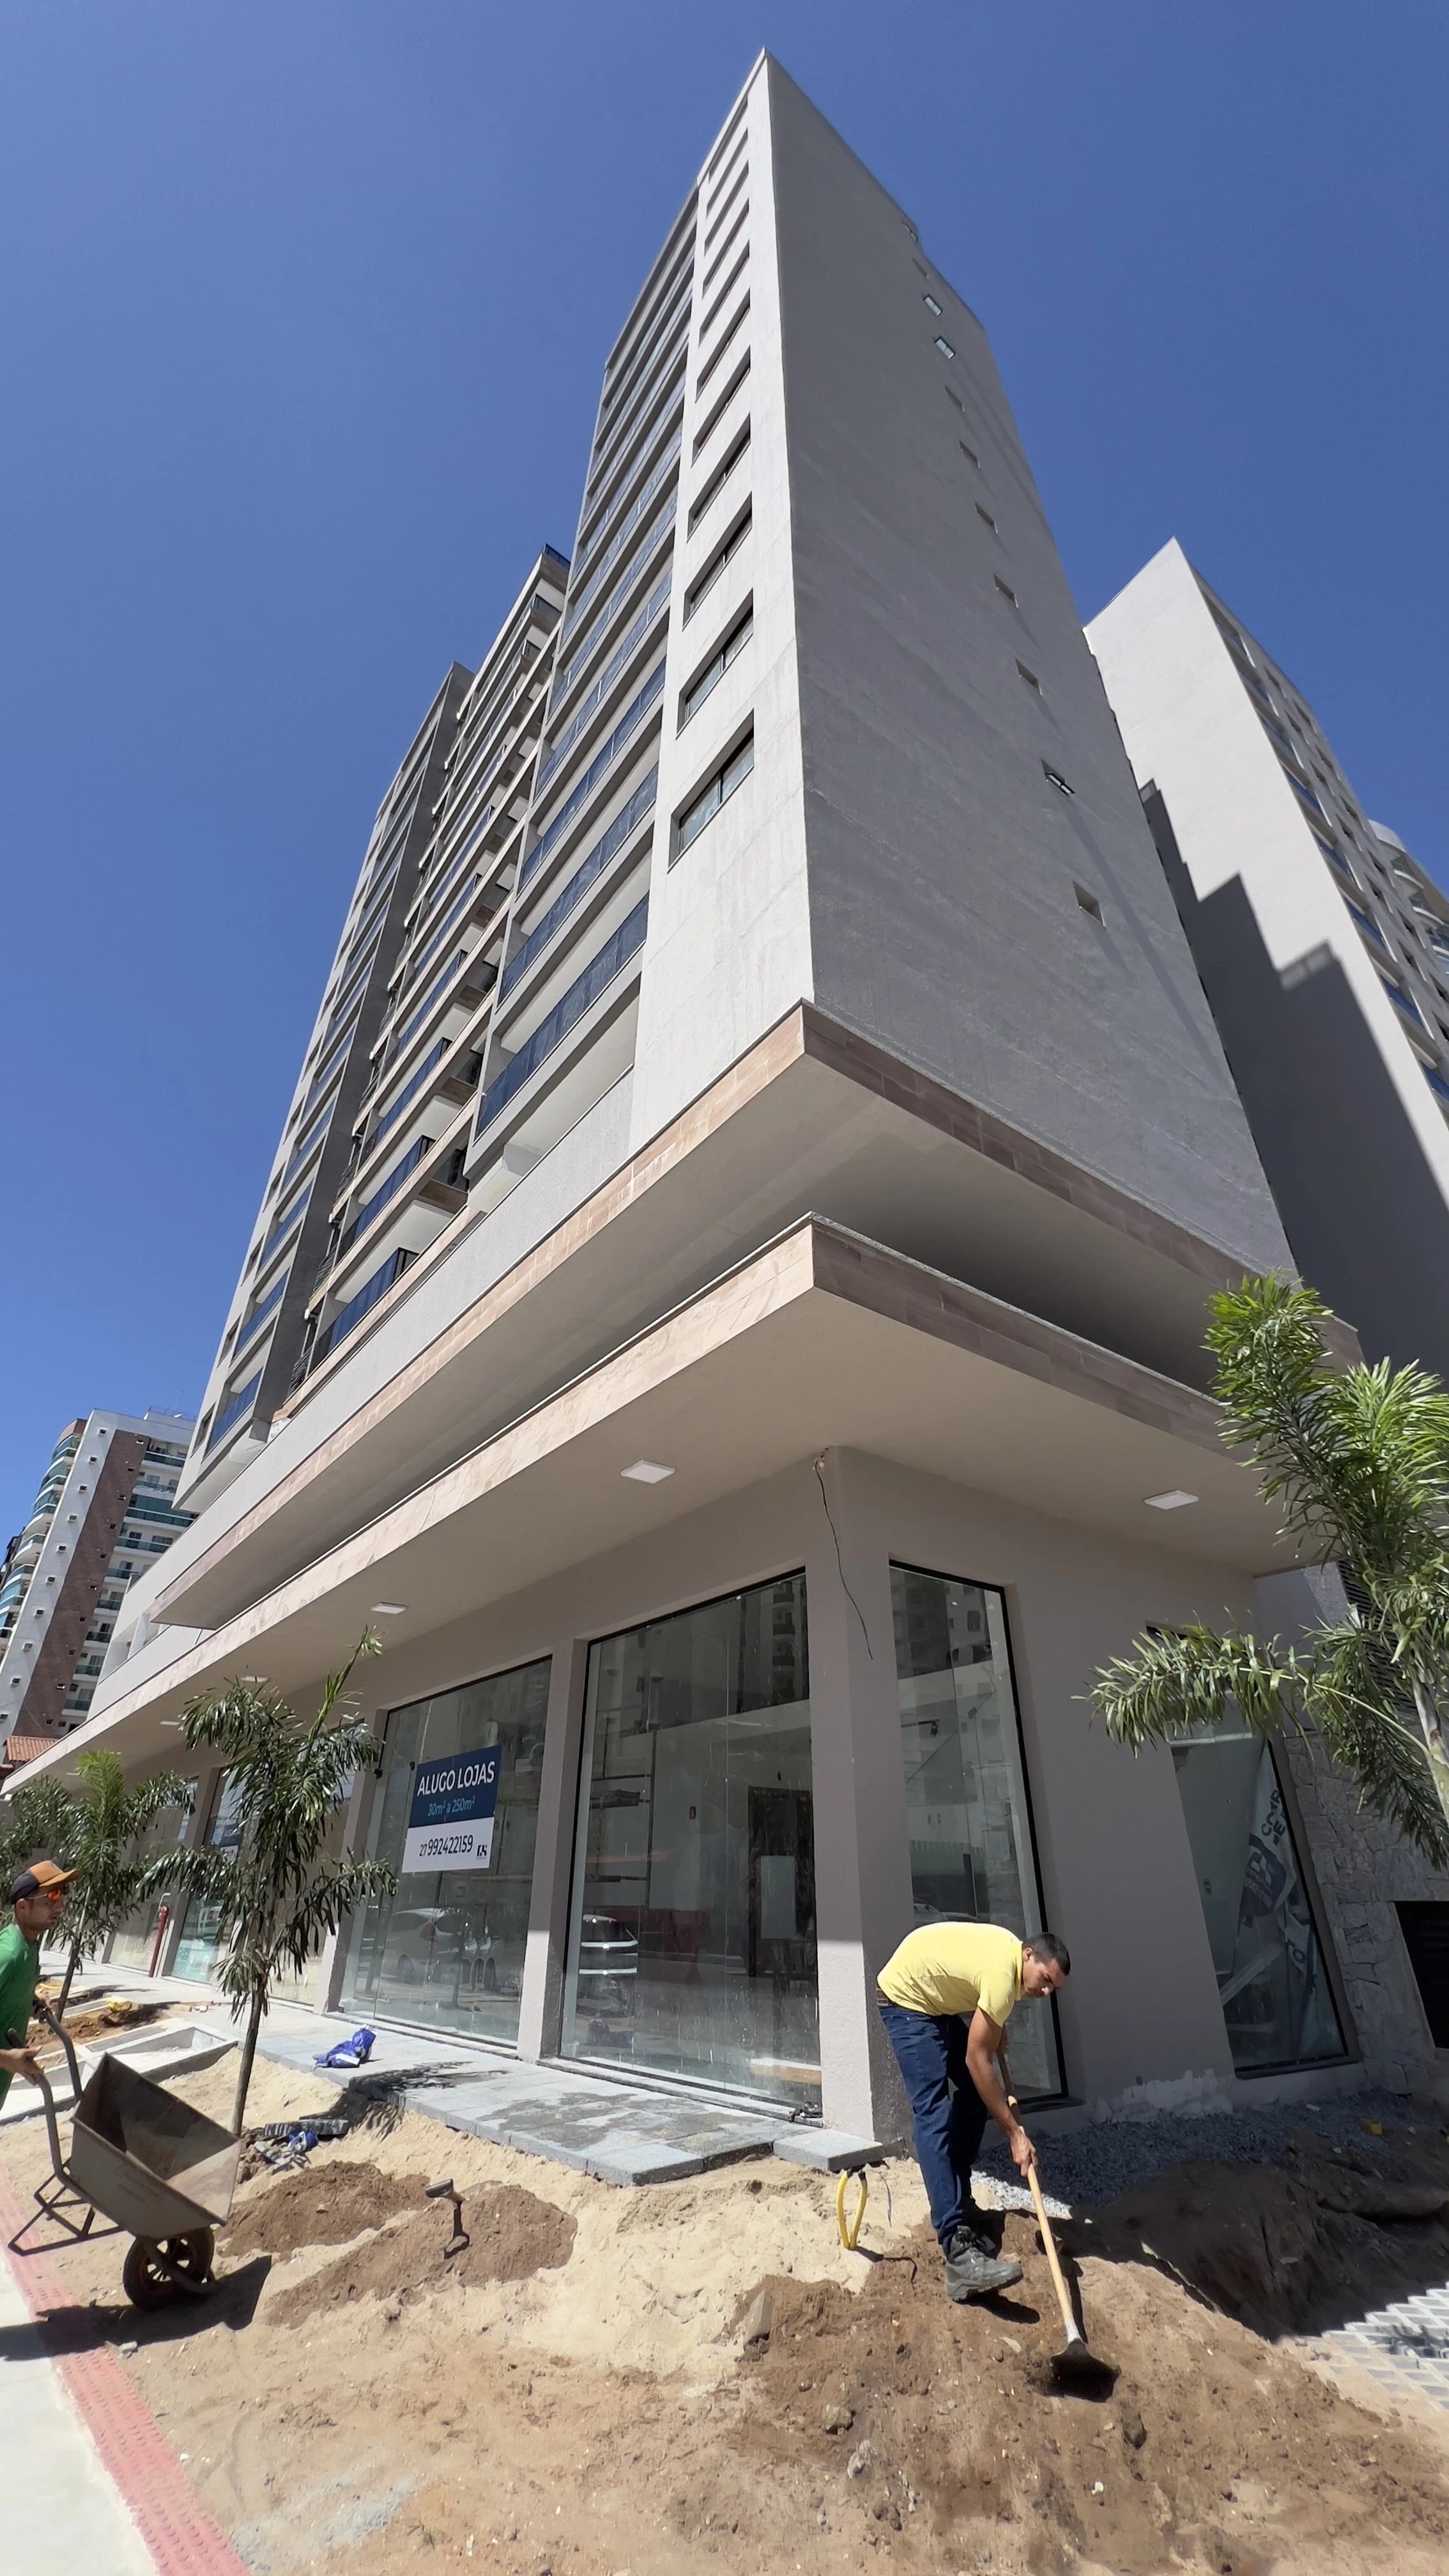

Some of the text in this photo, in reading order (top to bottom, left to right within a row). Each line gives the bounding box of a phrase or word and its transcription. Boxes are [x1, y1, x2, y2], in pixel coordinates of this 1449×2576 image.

[417, 1761, 495, 1797] ALUGO LOJAS
[446, 1803, 451, 1813] a
